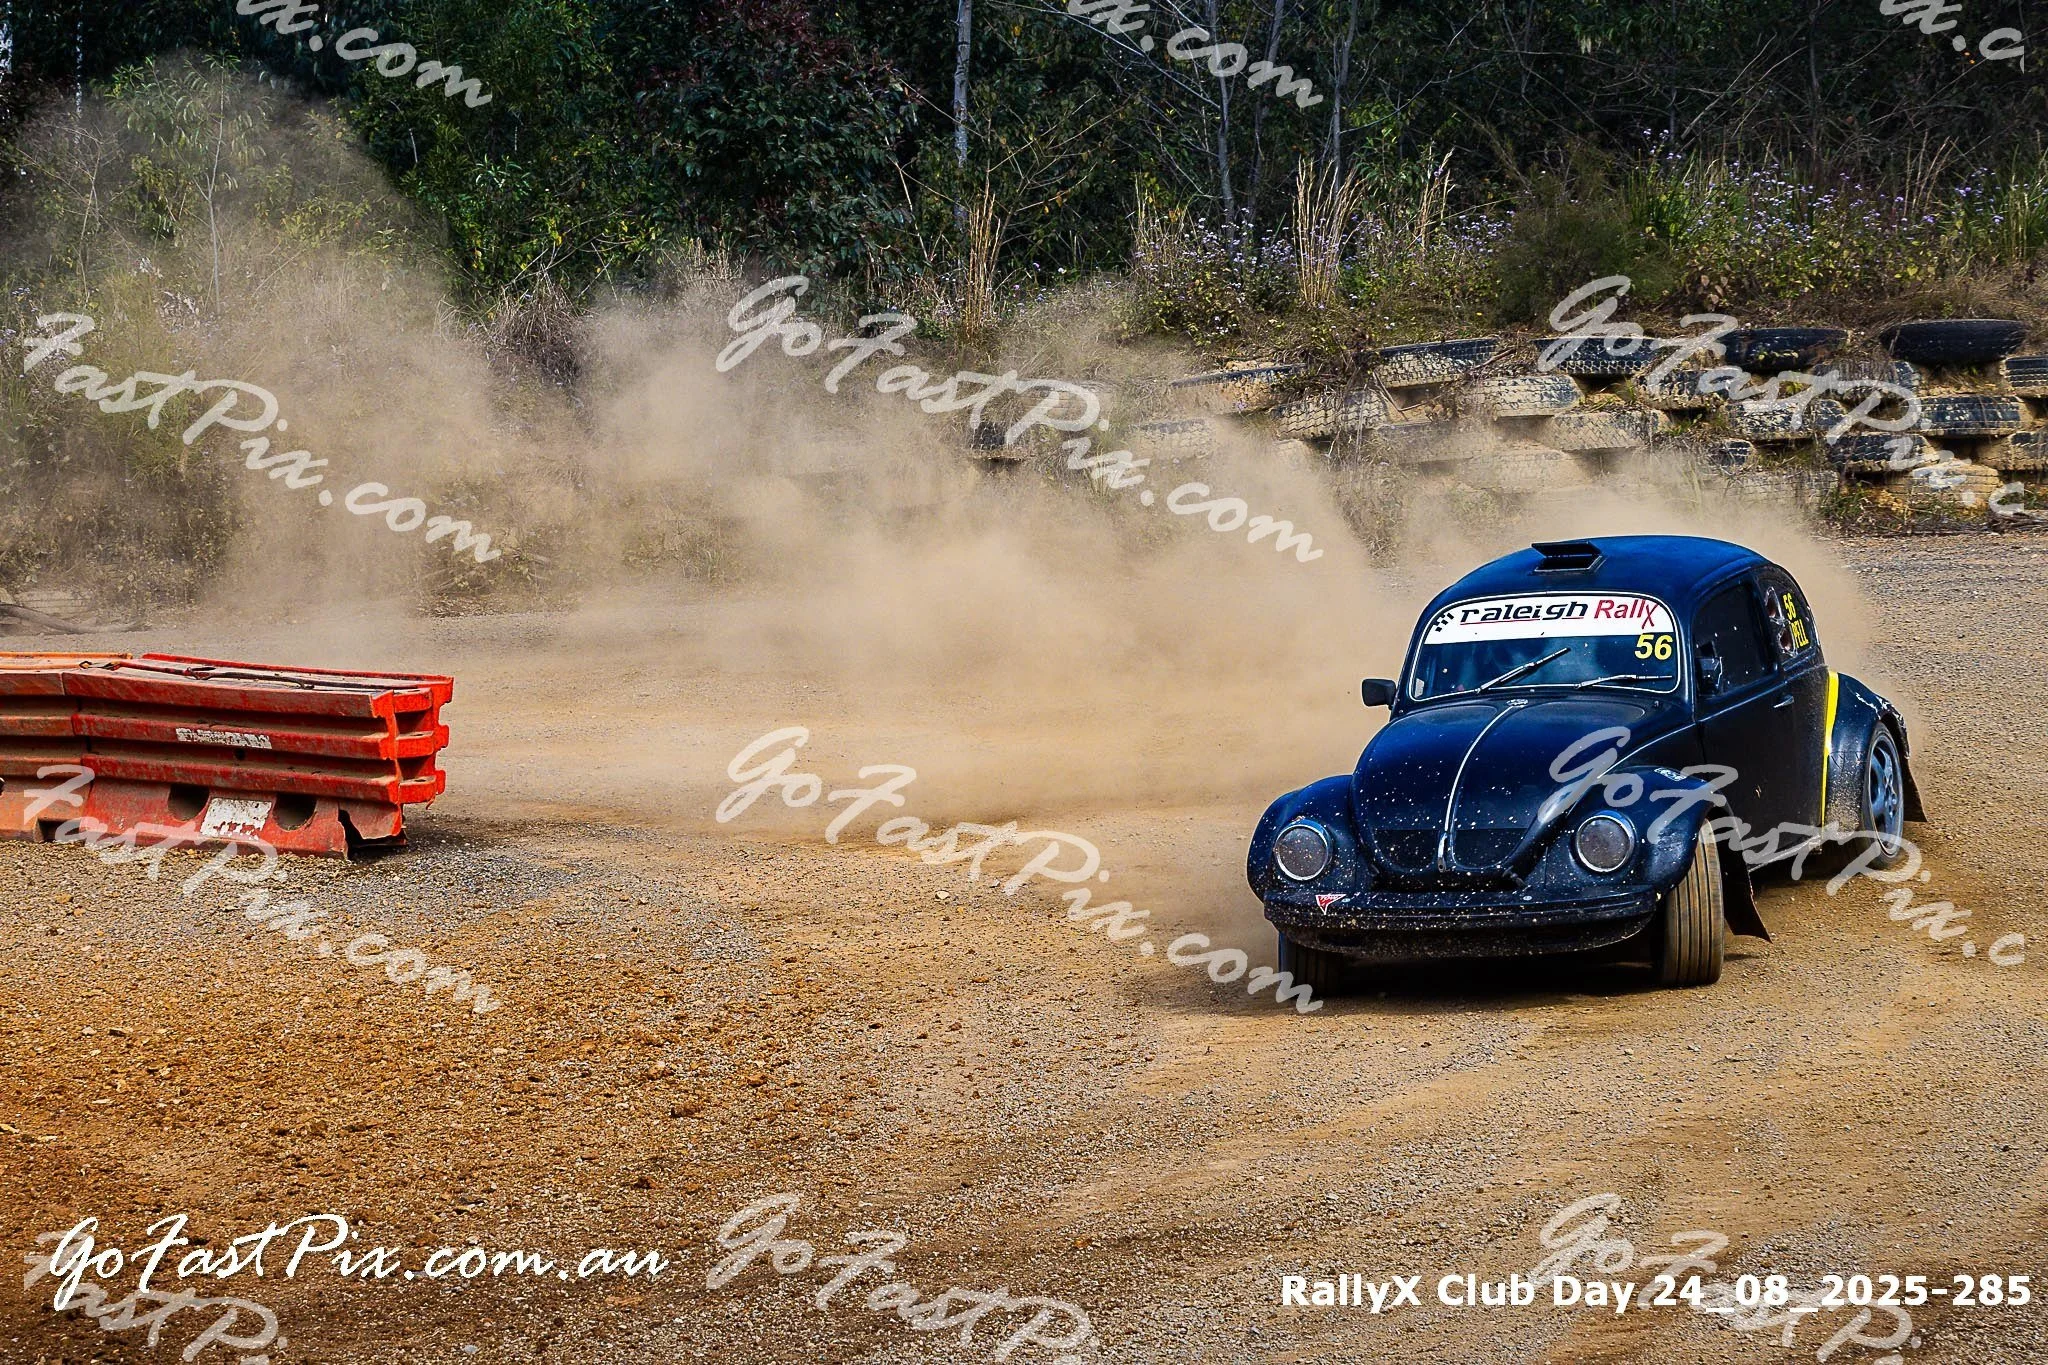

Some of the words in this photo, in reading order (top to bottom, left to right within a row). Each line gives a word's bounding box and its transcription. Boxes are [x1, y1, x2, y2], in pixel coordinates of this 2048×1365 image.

[1460, 601, 1588, 624] raleigh
[1782, 592, 1797, 621] 56
[1634, 634, 1674, 661] 56
